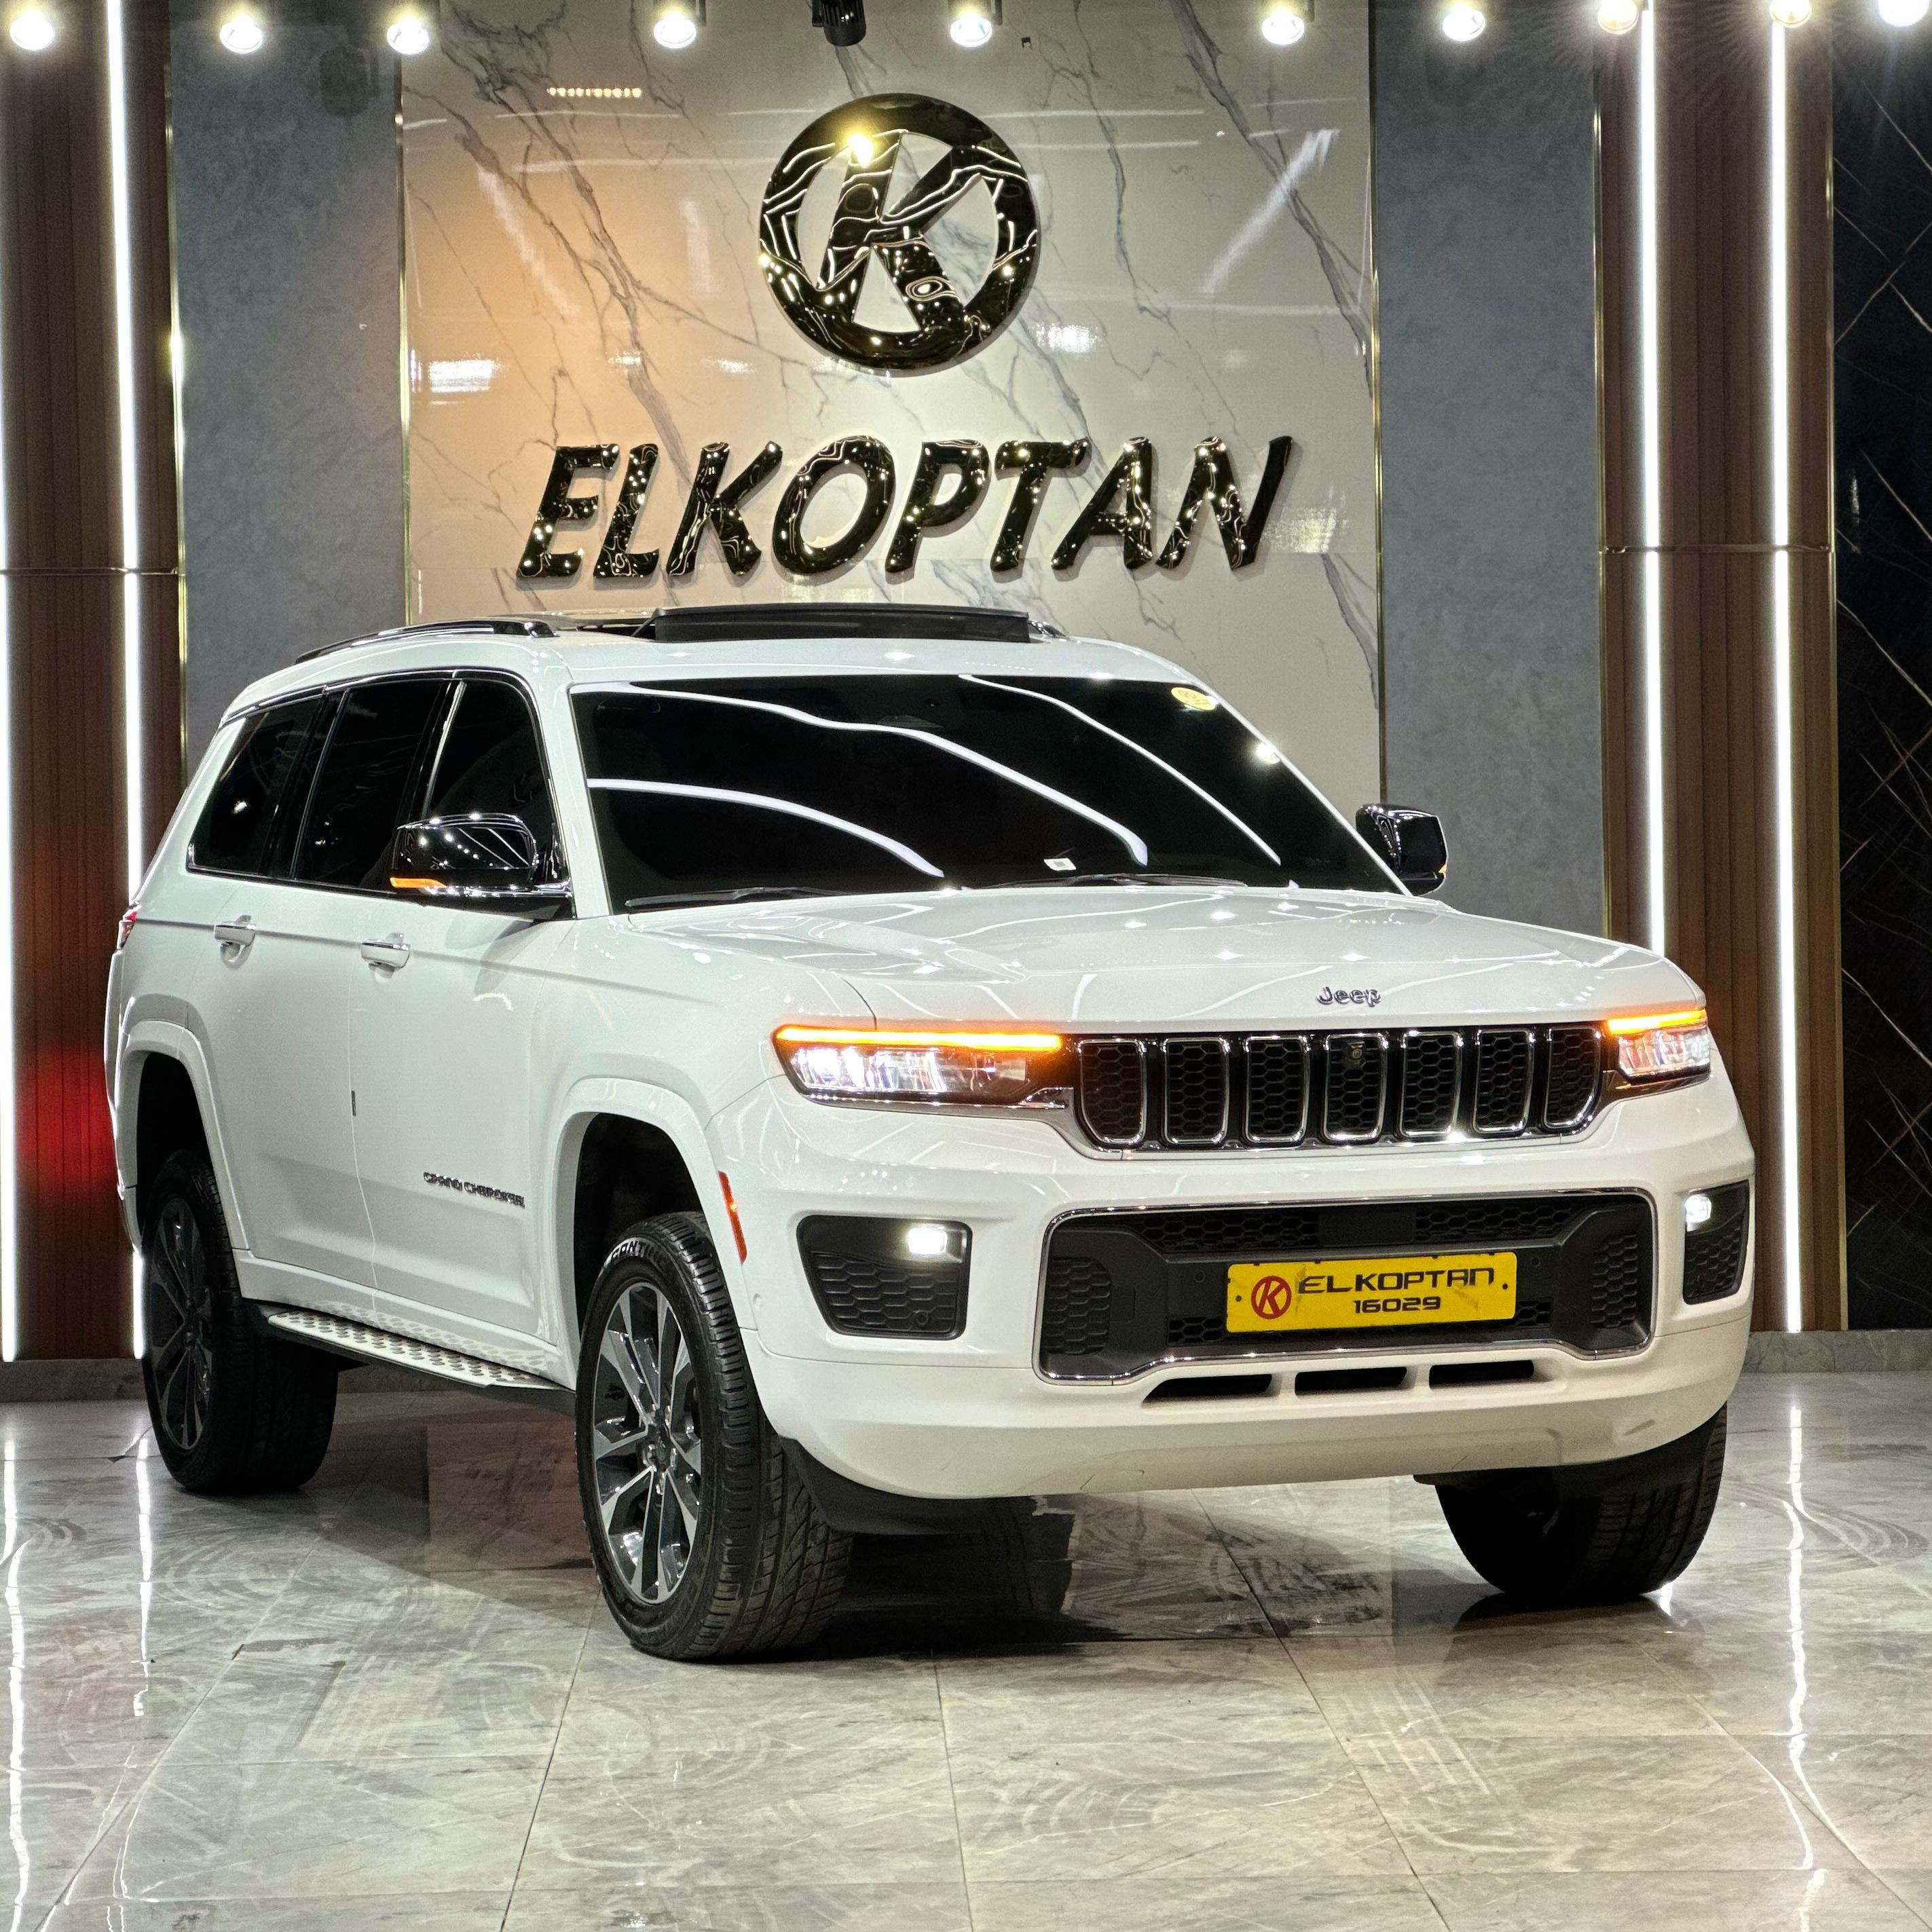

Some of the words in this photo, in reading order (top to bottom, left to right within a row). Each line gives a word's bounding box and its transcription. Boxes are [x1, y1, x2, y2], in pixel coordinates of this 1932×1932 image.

[517, 435, 1294, 578] ELKOPTAN
[1316, 986, 1381, 1007] Jeep
[1298, 1267, 1494, 1294] ELKOPTAN
[1352, 1296, 1441, 1314] 16029
